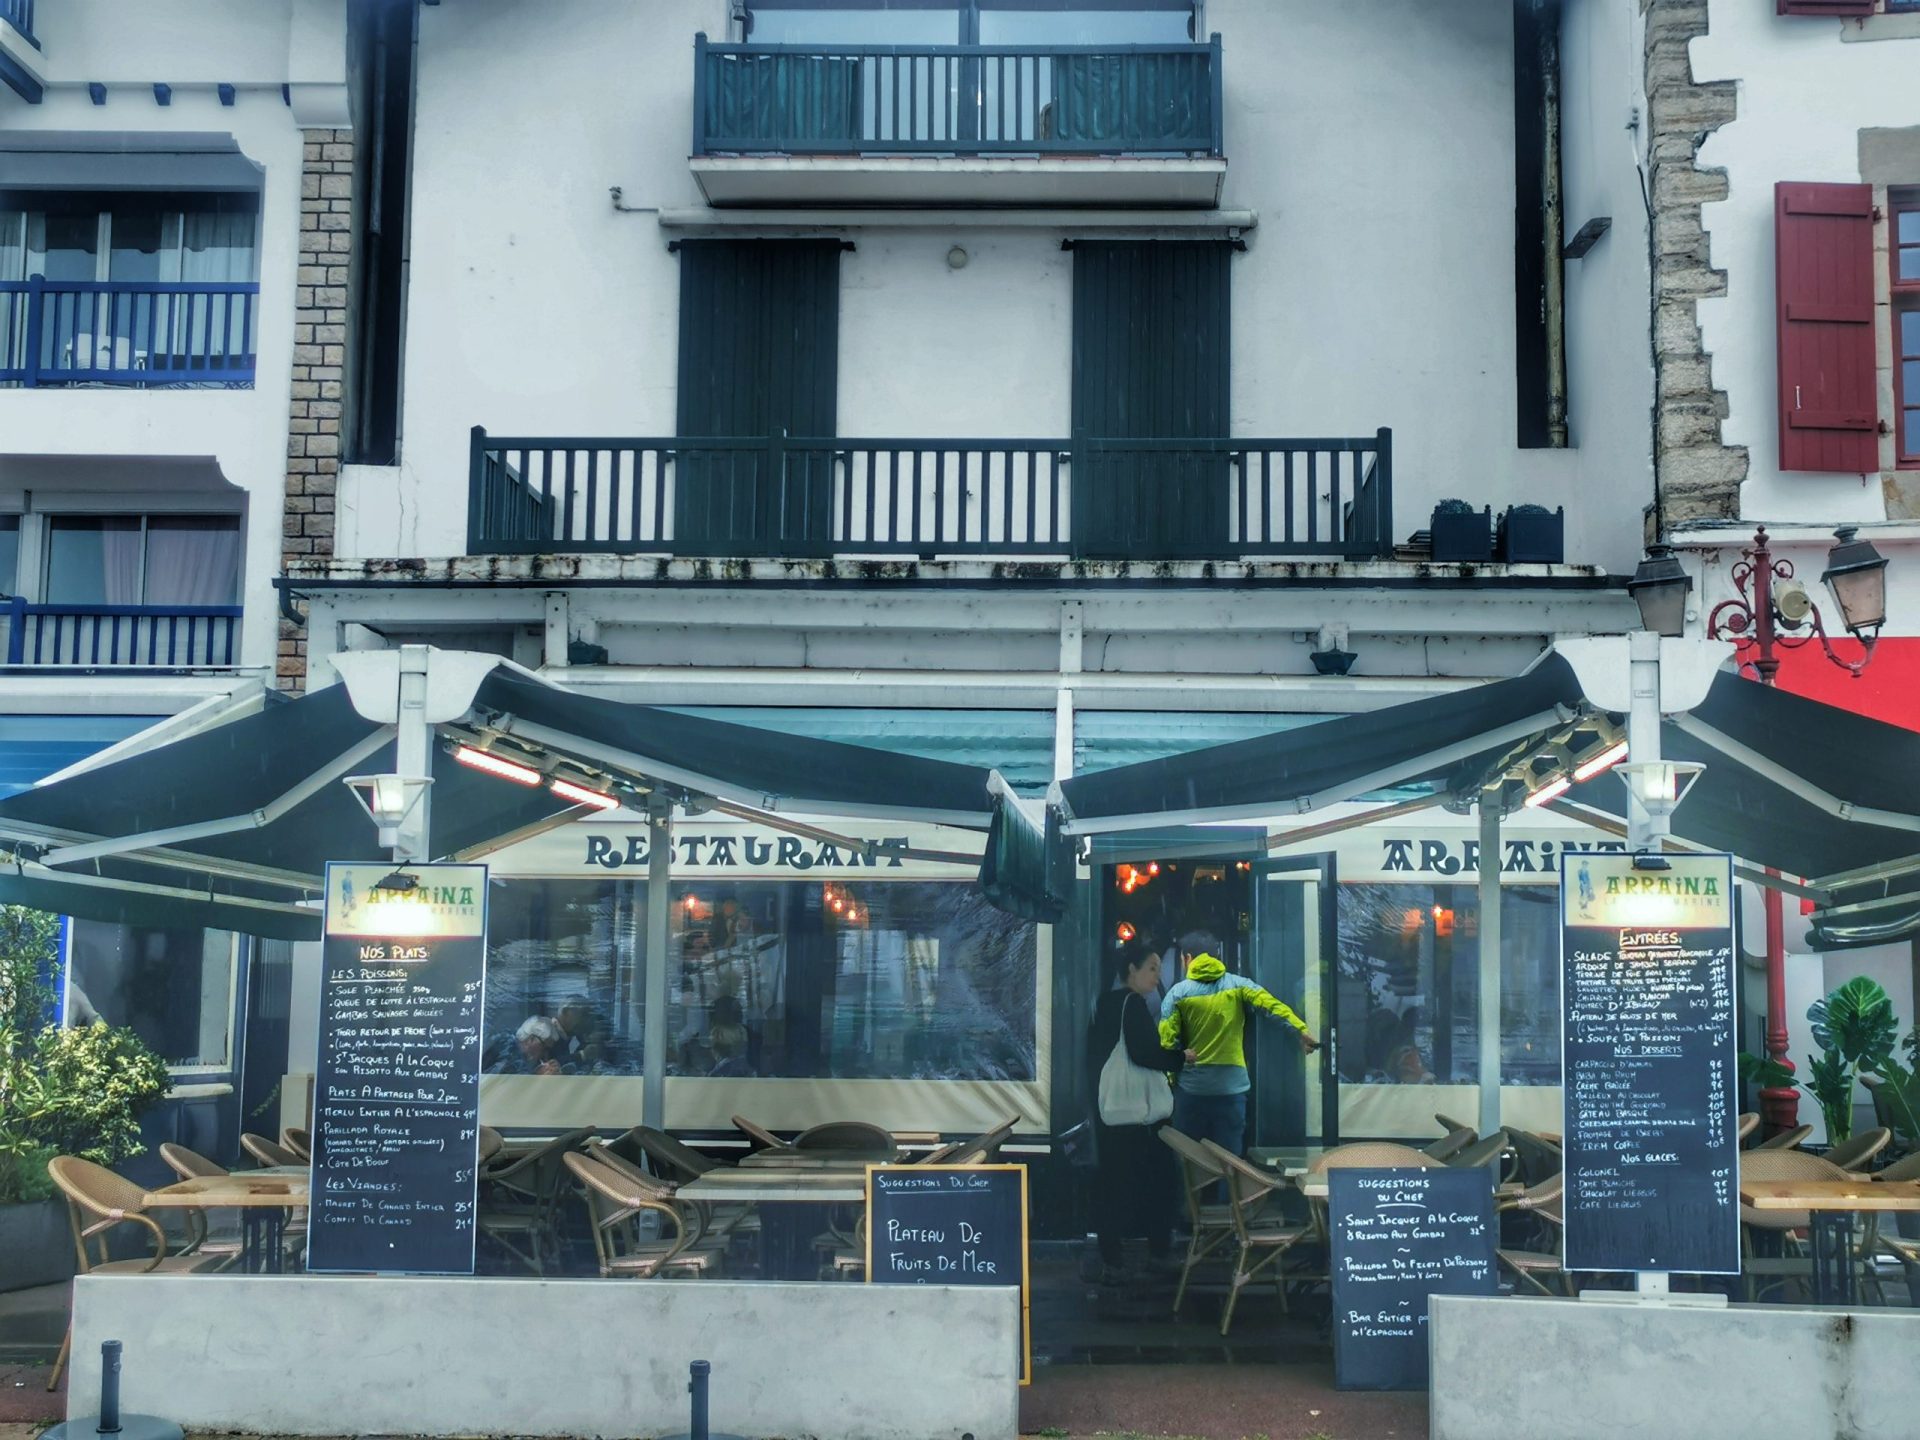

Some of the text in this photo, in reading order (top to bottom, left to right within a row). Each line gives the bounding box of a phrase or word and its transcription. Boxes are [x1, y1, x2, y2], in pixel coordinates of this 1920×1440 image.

[584, 835, 910, 869] RETAURANT
[360, 946, 385, 959] NOS
[1574, 951, 1611, 962] SALADE
[1629, 960, 1659, 969] JAMBON
[332, 969, 354, 979] LES
[1626, 969, 1641, 977] FOIE
[336, 986, 357, 994] SOLE
[365, 983, 406, 994] PLANCHÉE
[334, 999, 360, 1007] QUEUE
[335, 1007, 368, 1020] GAMBAS
[372, 1009, 408, 1018] SAUVAGES
[1571, 1010, 1603, 1021] PLATEAU
[1662, 1013, 1678, 1021] MER
[360, 1028, 390, 1036] RETOUR
[391, 1028, 401, 1036] DE
[464, 1036, 478, 1045] 33€
[1586, 1034, 1618, 1043] SOUPE
[1624, 1033, 1636, 1041] DE
[1614, 1044, 1682, 1054] NOS DESSERTS
[348, 1053, 389, 1064] JACQUES
[420, 1055, 455, 1068] COQUE
[353, 1066, 391, 1075] RISOTTO
[394, 1067, 411, 1076] AUX
[414, 1070, 448, 1079] GAMBAS
[1576, 1072, 1595, 1080] BABA
[1601, 1072, 1611, 1080] AU
[329, 1086, 356, 1097] PLATS
[362, 1085, 371, 1096] A
[374, 1088, 414, 1099] PARTAGER
[417, 1089, 434, 1100] POUR
[437, 1089, 445, 1101] 2
[325, 1108, 354, 1116] MERLU
[360, 1107, 390, 1117] ENTIER
[394, 1107, 403, 1117] A
[406, 1108, 461, 1118] L'ESPAGNOLE
[324, 1122, 368, 1134] PARILLADA
[374, 1124, 411, 1135] ROYALE
[1578, 1130, 1612, 1139] FROMAGE
[327, 1156, 349, 1168] CÔTE
[352, 1157, 363, 1167] DE
[1621, 1153, 1640, 1163] NOS
[1578, 1167, 1620, 1177] COLONEL
[326, 1177, 344, 1189] LES
[878, 1175, 989, 1188] SUGGESTIONS DU CHEF
[1358, 1178, 1430, 1188] SUGGESTIONS
[1377, 1191, 1424, 1202] DU CHEF
[1580, 1190, 1617, 1198] CHOCOLAT
[325, 1199, 356, 1208] MAGRET
[362, 1199, 373, 1209] DE
[379, 1200, 411, 1211] CANARD
[416, 1201, 445, 1211] ENTIER
[324, 1214, 355, 1223] CONFIT
[364, 1216, 375, 1224] DE
[379, 1216, 412, 1225] CANARD
[1345, 1214, 1374, 1226] SAINT
[1378, 1214, 1420, 1224] JACQUES
[1449, 1213, 1479, 1223] COQUE
[888, 1219, 983, 1244] PLATEAU DE
[1356, 1232, 1388, 1240] RISOTTO
[1412, 1227, 1445, 1239] GAMBAS
[890, 1250, 996, 1274] FRUITS DE MER
[1344, 1257, 1387, 1270] PARILLADA
[1392, 1259, 1406, 1269] DE
[1443, 1258, 1454, 1267] DE
[1348, 1311, 1371, 1324] BAR
[1377, 1311, 1412, 1323] ENTIER
